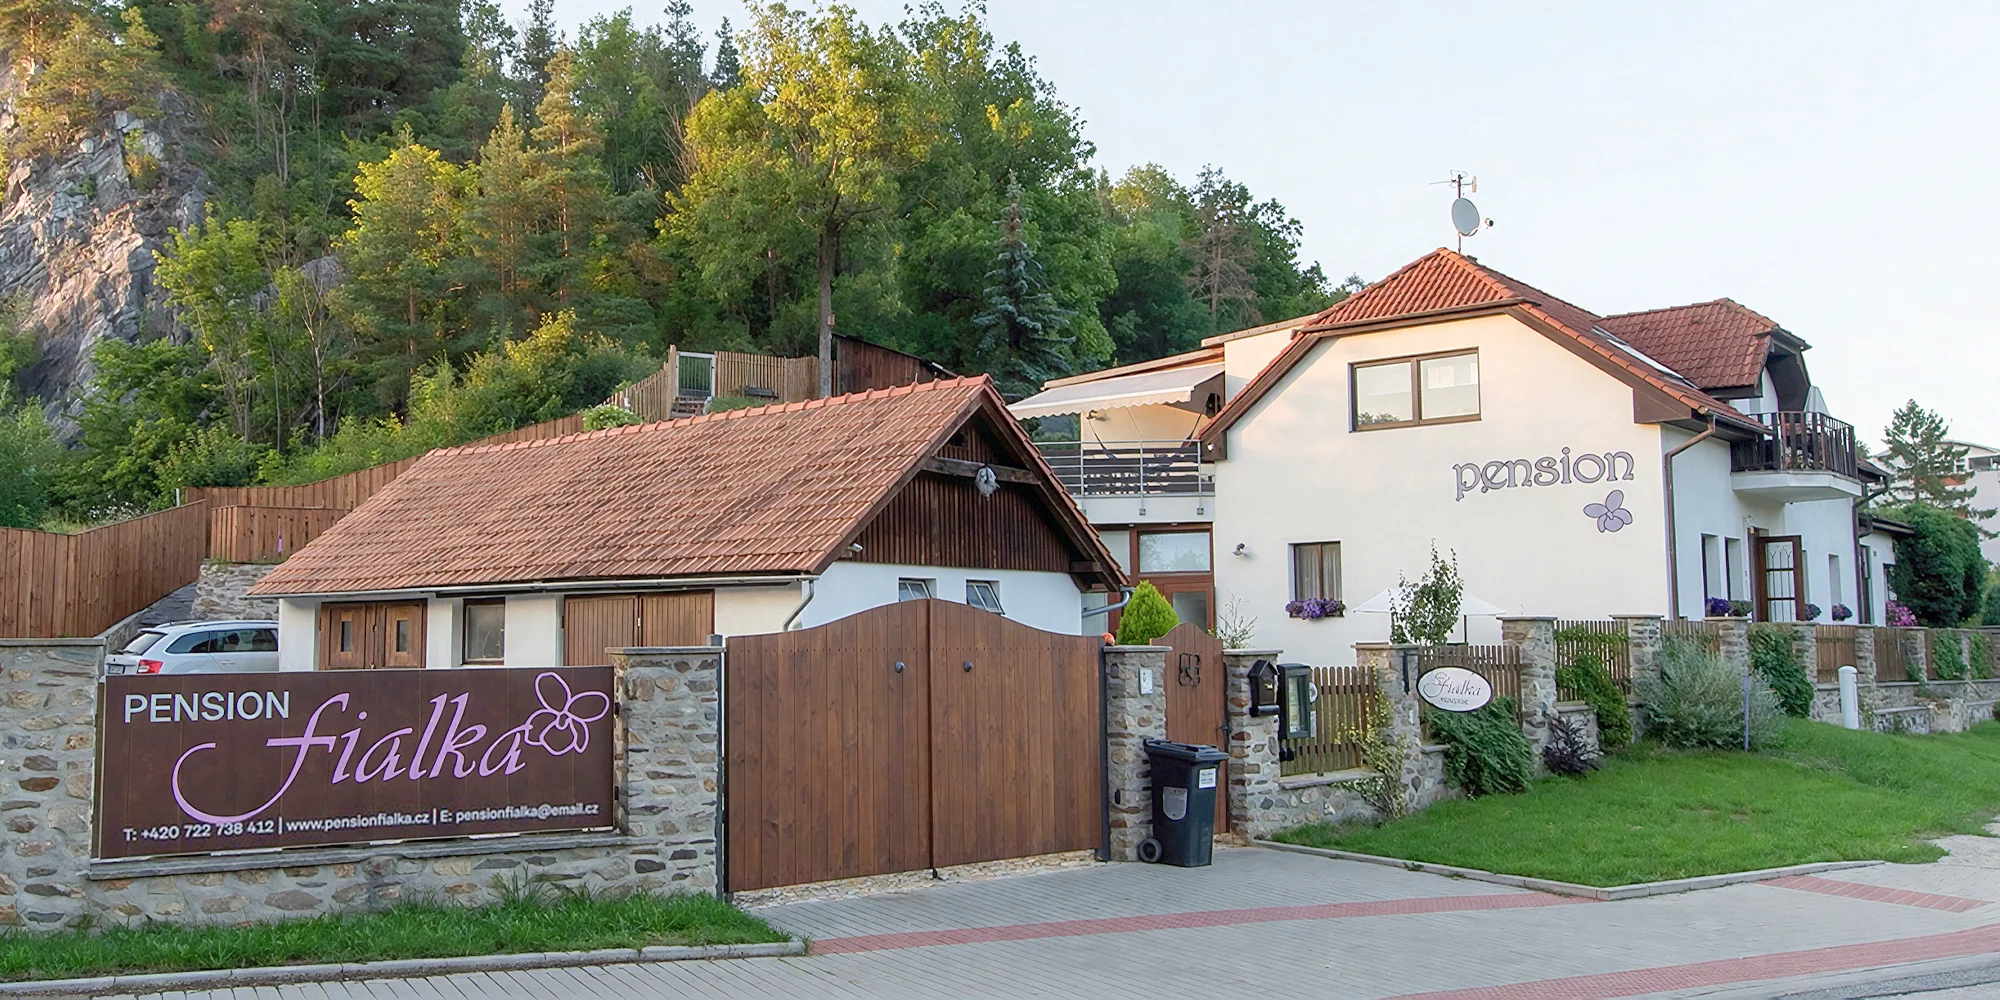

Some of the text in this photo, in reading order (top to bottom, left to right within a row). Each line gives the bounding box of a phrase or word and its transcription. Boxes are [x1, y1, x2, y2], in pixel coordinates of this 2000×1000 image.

[1452, 446, 1635, 502] pension
[124, 690, 290, 723] PENSION
[123, 828, 137, 841] T:
[140, 825, 180, 840] +420
[183, 823, 212, 838] 722
[215, 821, 244, 836] 738
[246, 819, 275, 835] 412
[286, 813, 429, 831] www.pensionfialka.cz
[440, 809, 453, 823] E:
[456, 803, 599, 823] pensionfialka@email.cz
